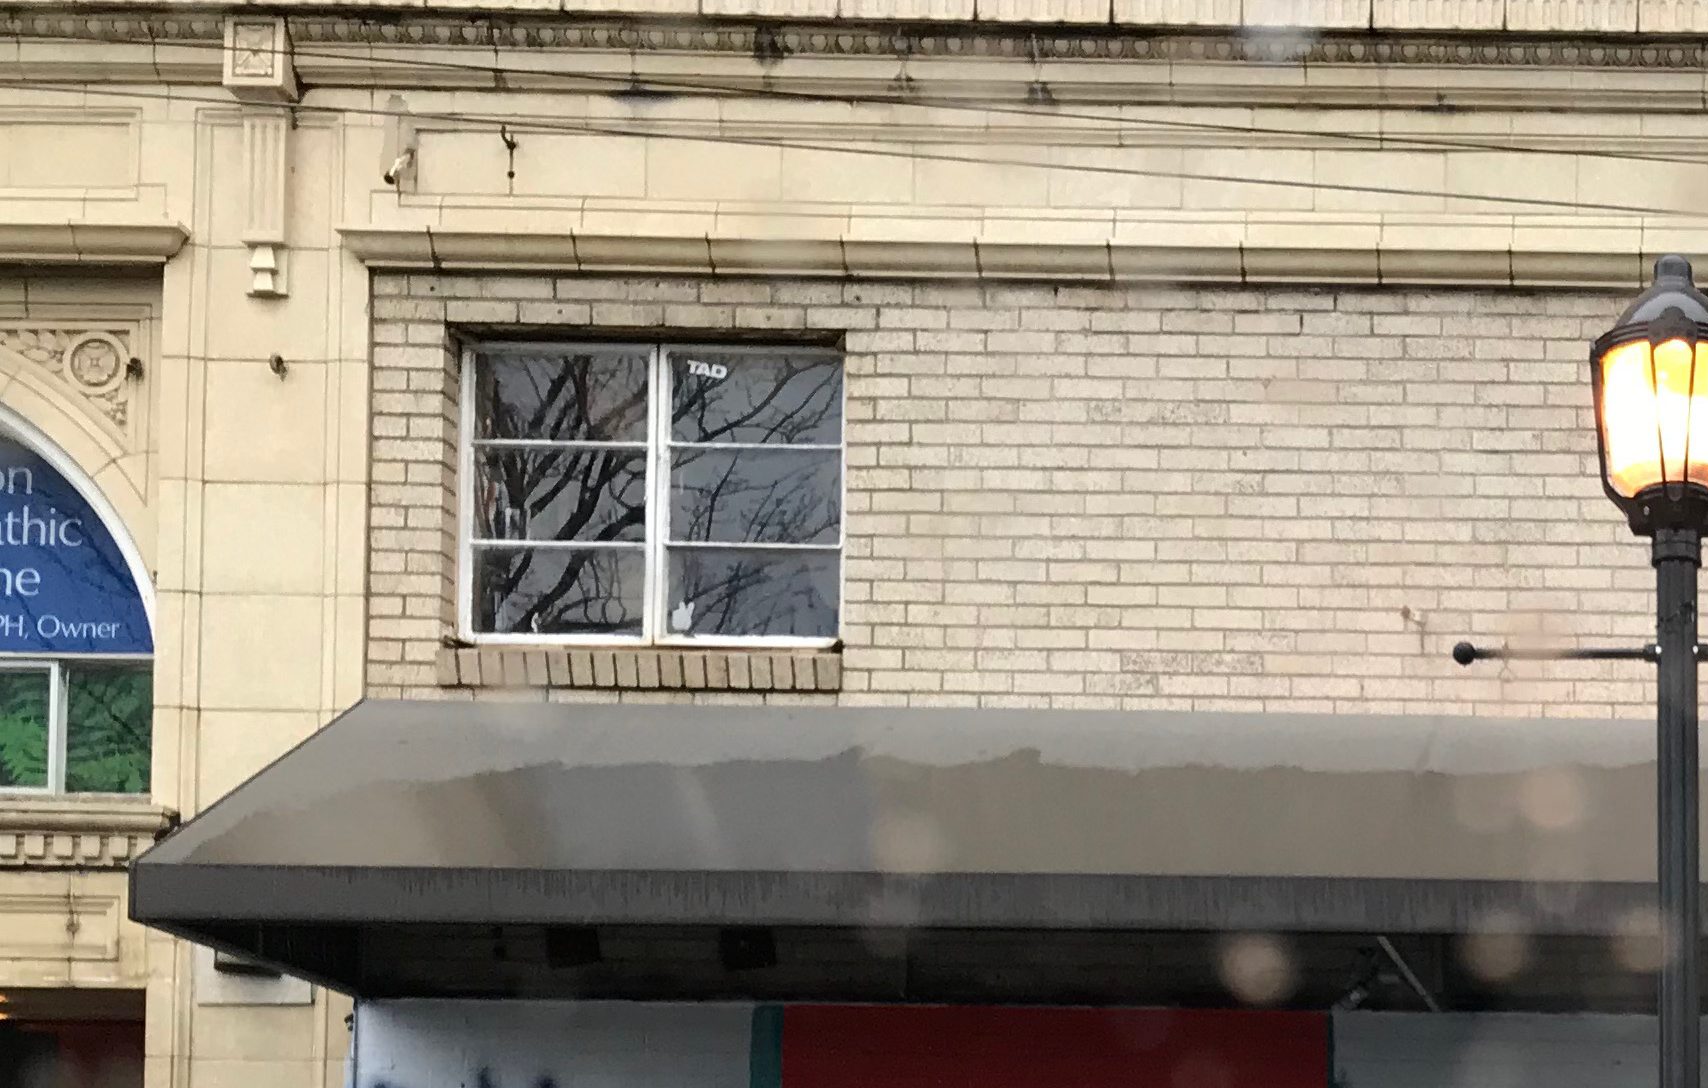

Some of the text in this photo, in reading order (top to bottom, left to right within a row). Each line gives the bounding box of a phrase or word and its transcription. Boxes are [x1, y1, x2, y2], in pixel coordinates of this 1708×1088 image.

[686, 359, 728, 379] TAD
[0, 505, 83, 547] thic
[37, 614, 121, 639] Owner
